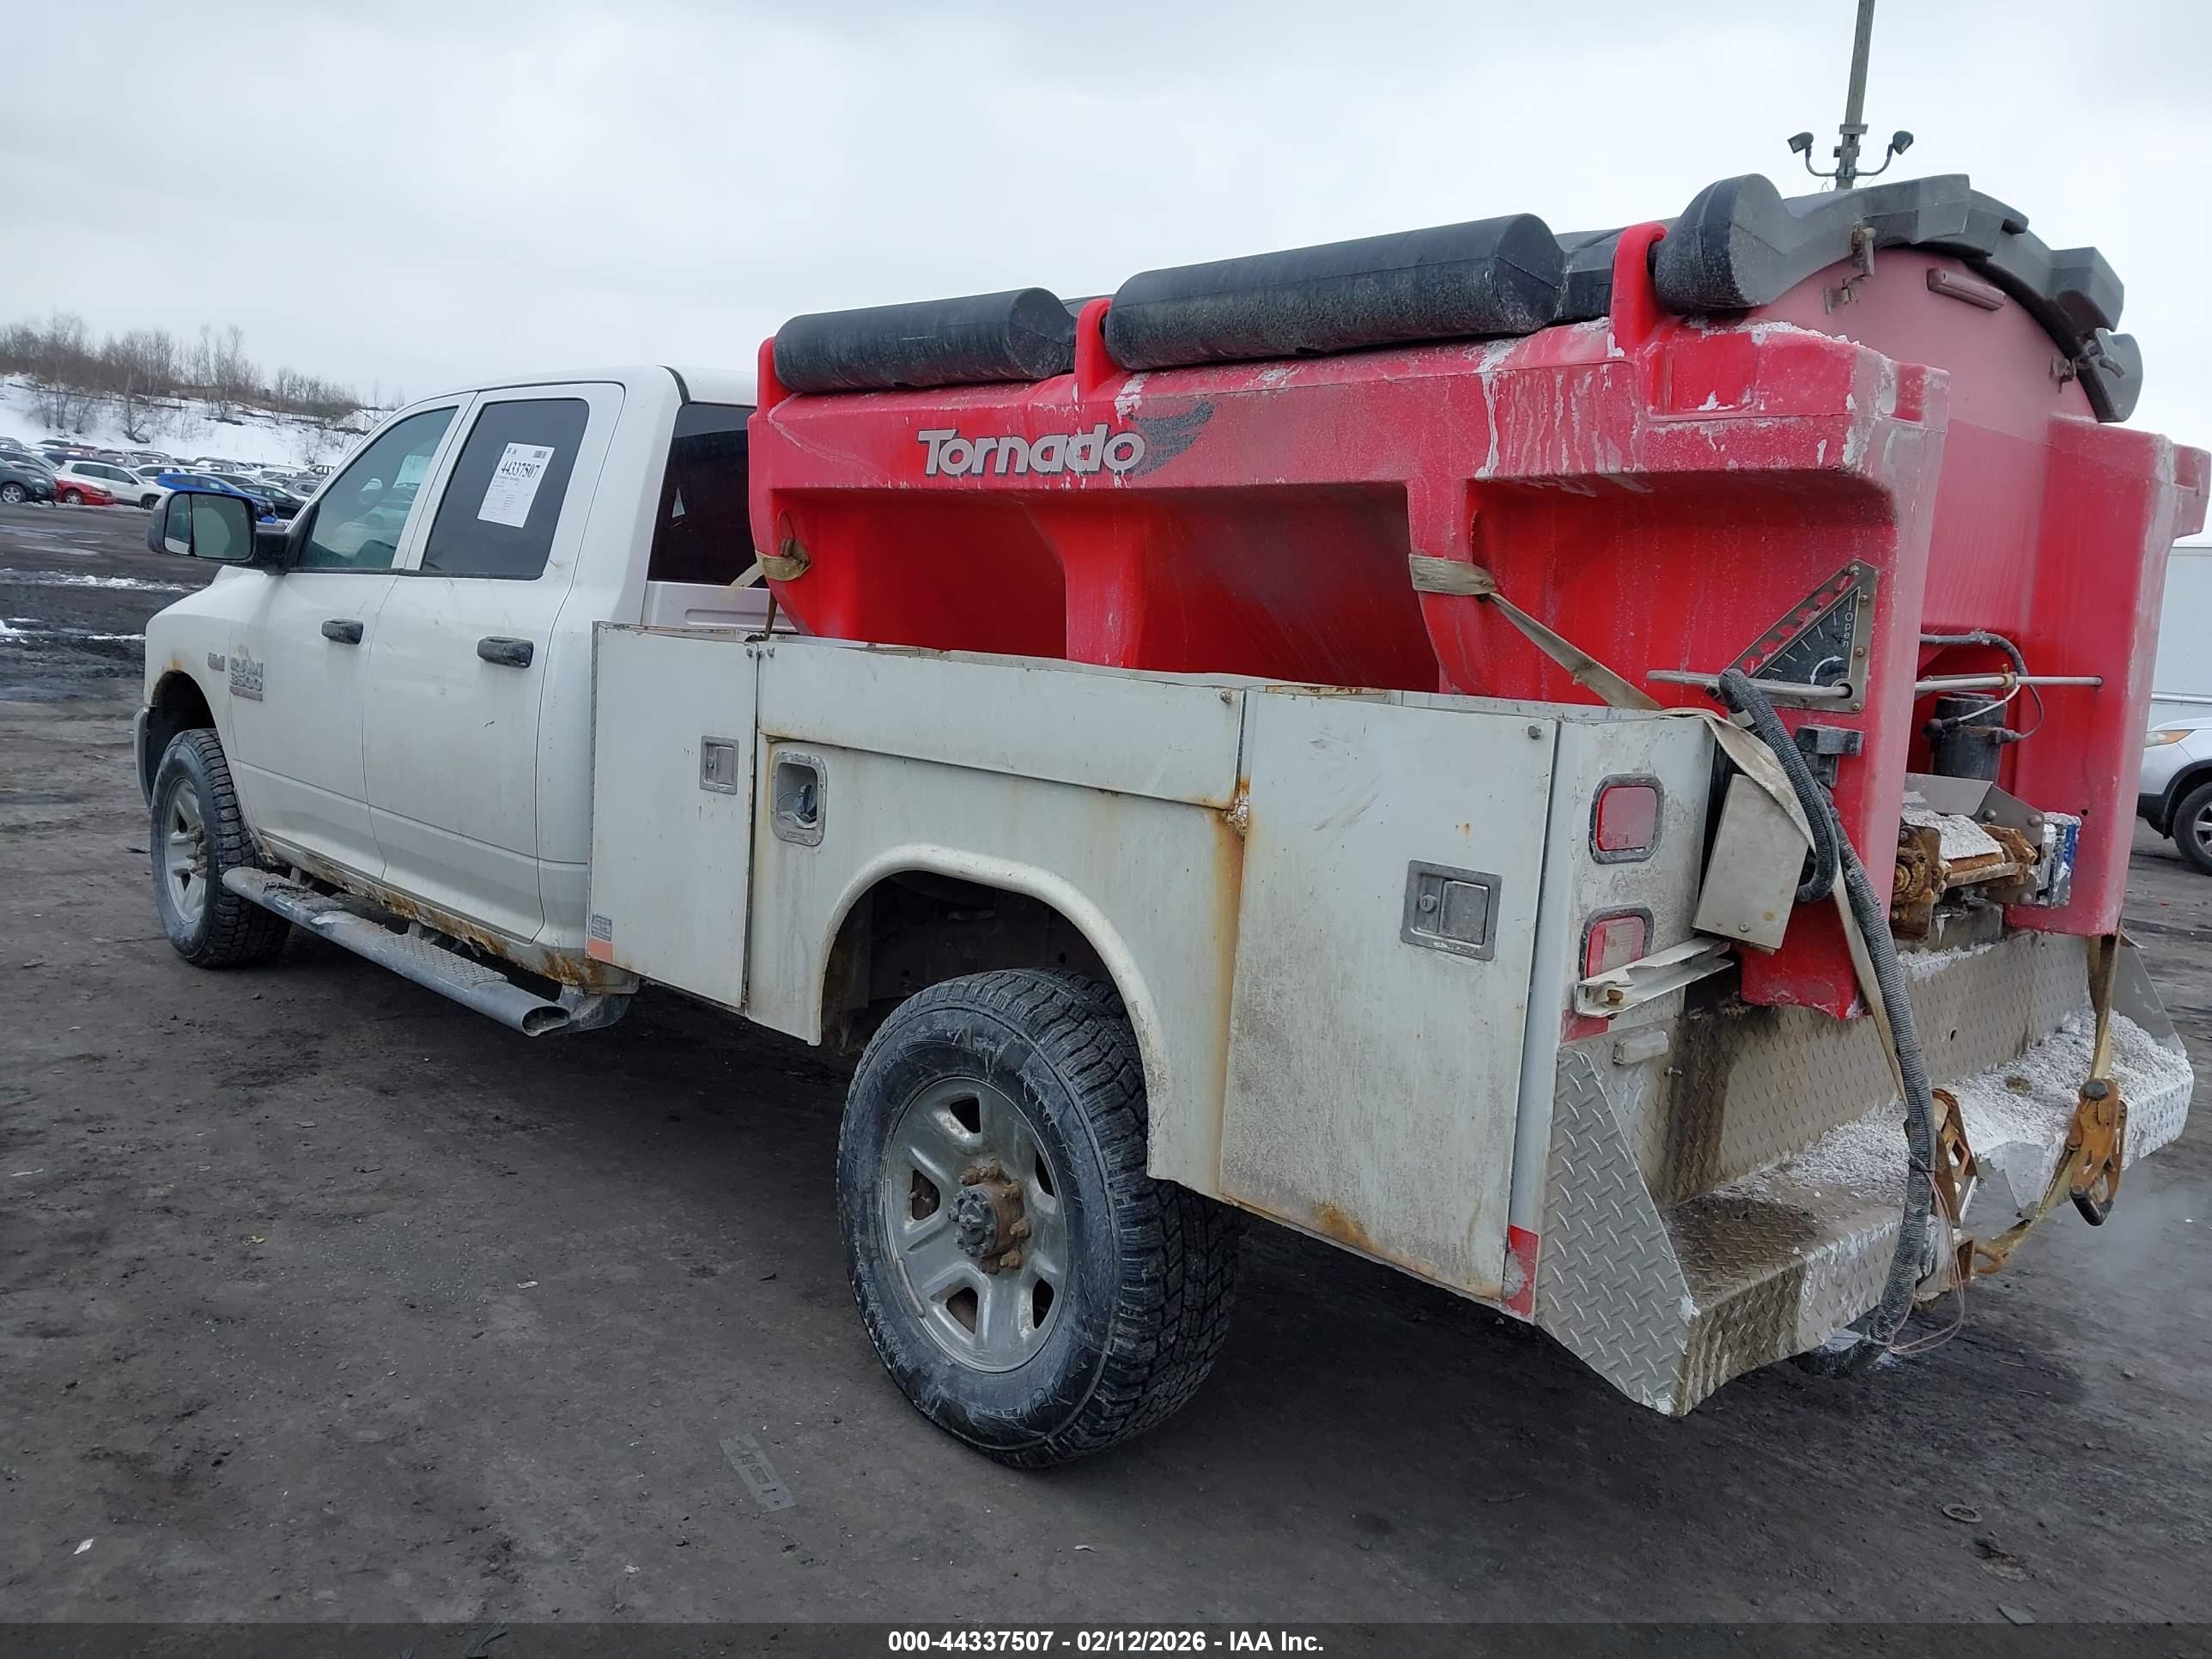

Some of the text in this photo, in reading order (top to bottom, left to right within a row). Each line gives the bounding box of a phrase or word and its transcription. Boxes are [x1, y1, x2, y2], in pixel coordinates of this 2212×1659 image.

[917, 424, 1146, 476] Tornado
[501, 459, 541, 479] 44337507
[1842, 611, 1854, 647] Open
